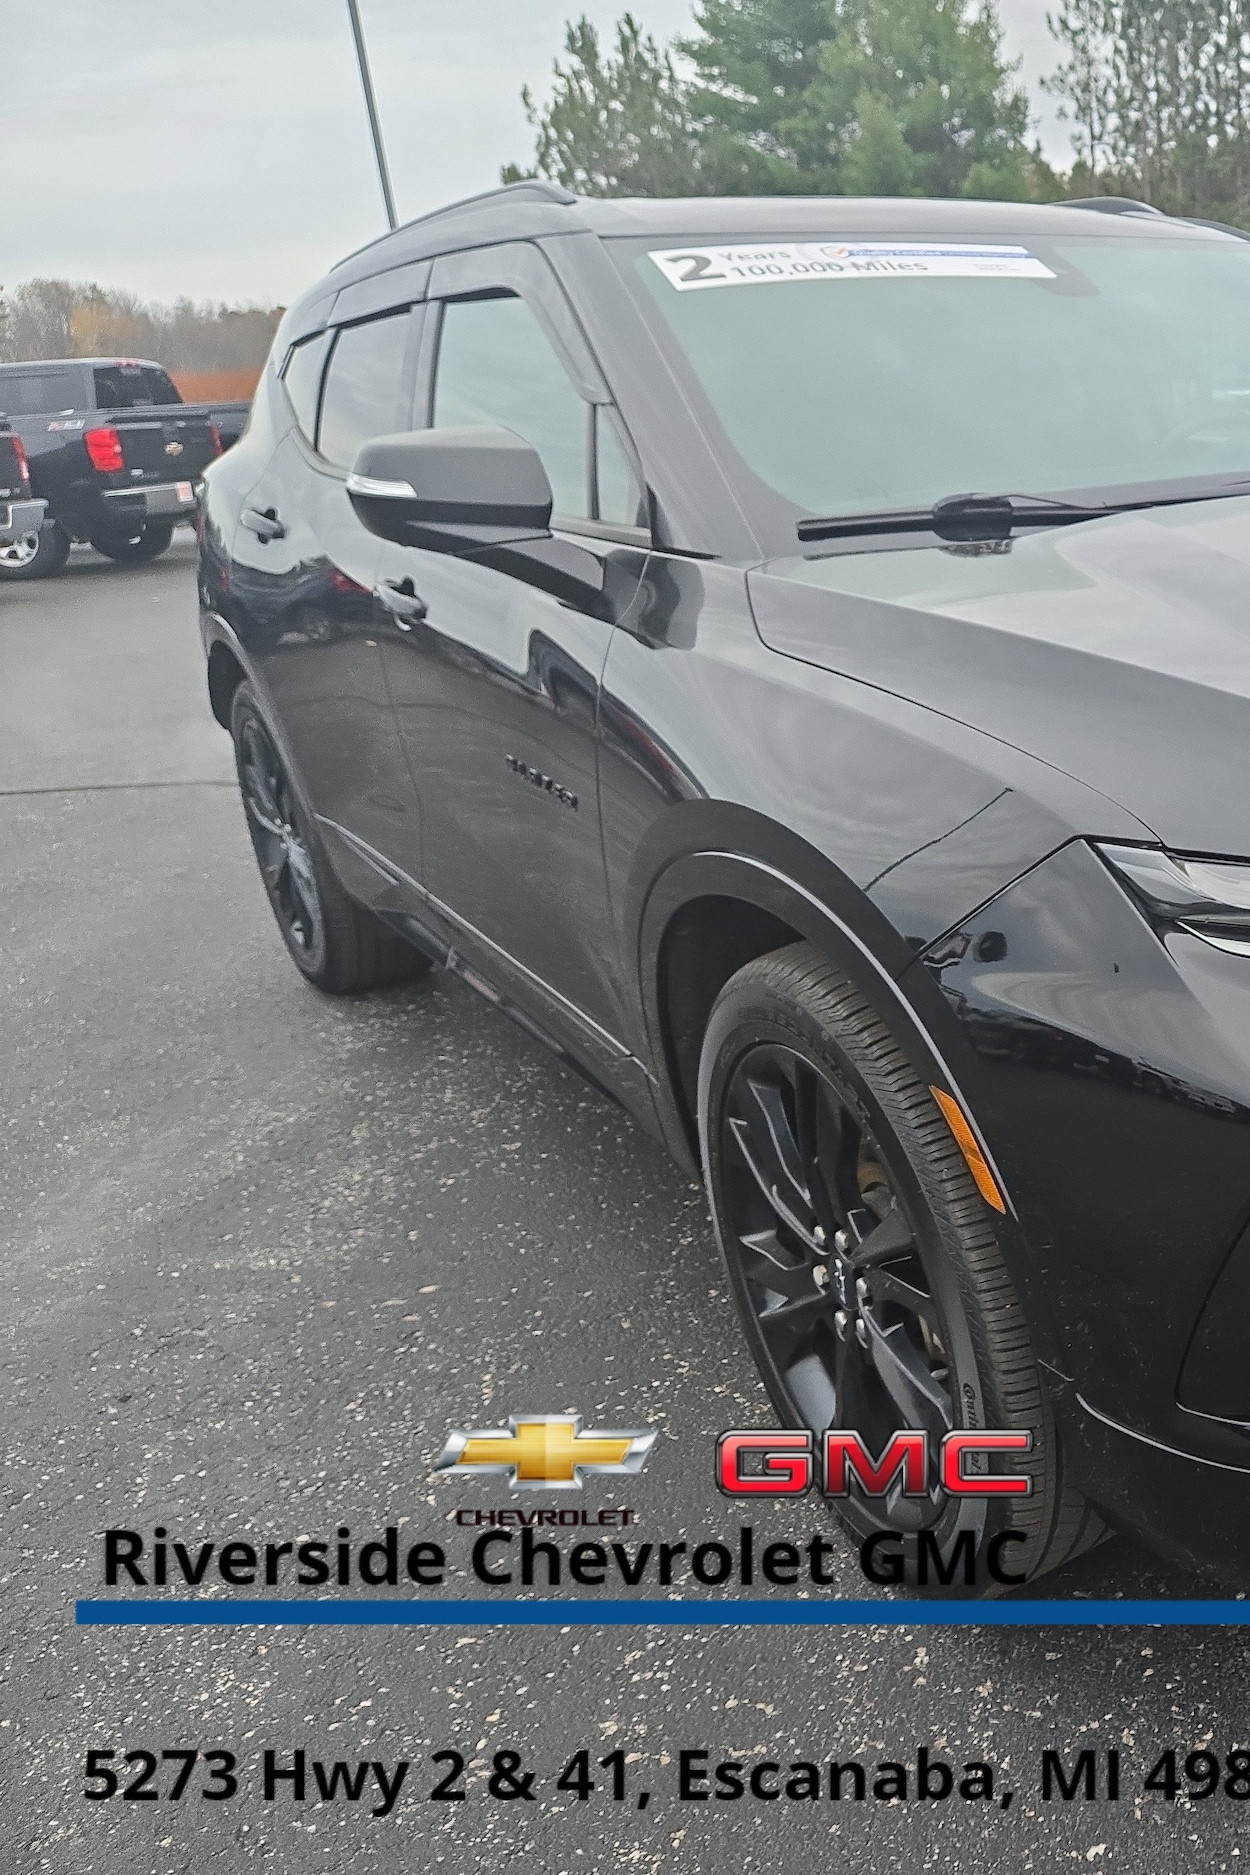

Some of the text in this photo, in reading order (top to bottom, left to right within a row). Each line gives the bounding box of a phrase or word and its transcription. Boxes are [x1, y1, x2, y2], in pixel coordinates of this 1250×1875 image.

[717, 251, 791, 261] Years
[664, 255, 727, 282] 2
[850, 260, 928, 272] Miles
